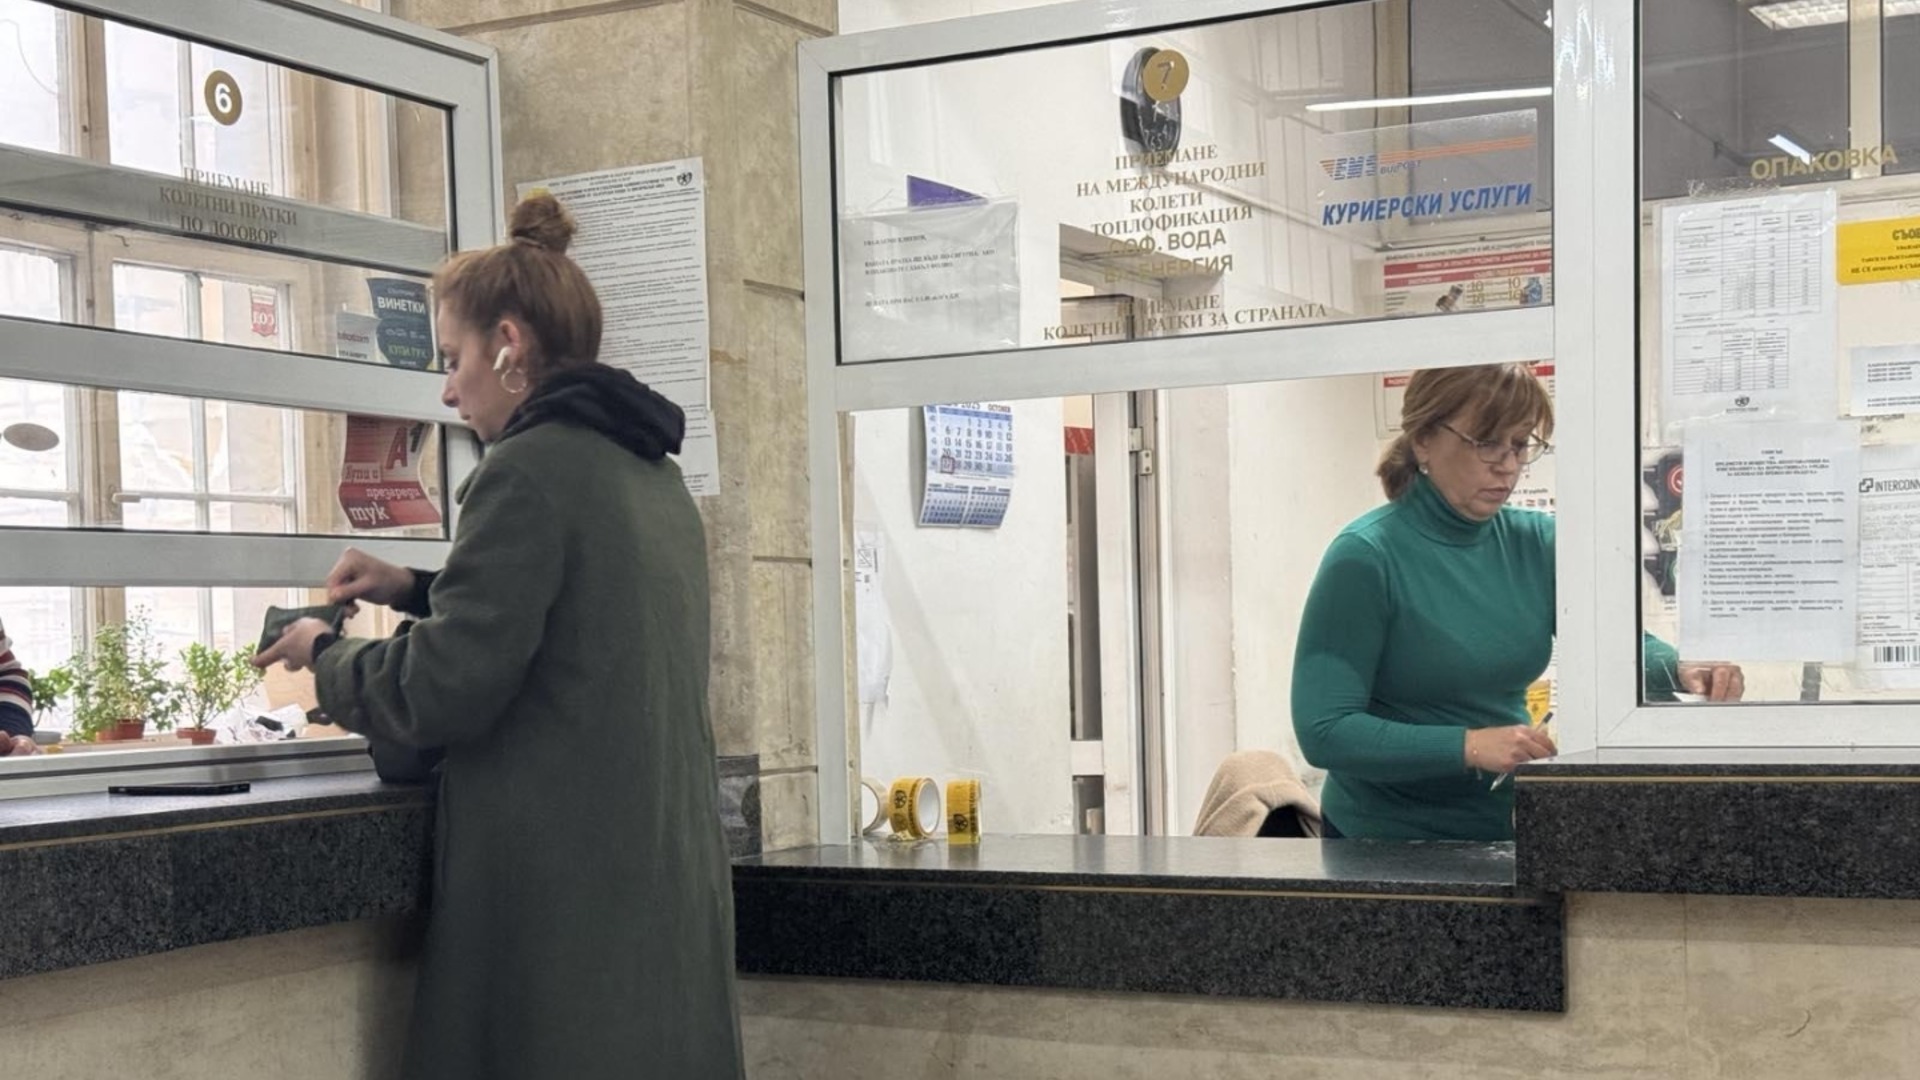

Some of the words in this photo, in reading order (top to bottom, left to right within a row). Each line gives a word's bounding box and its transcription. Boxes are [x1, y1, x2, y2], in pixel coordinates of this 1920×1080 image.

[214, 82, 232, 113] 6
[1115, 144, 1218, 171] ПРИЕМАНЕ
[1751, 144, 1899, 180] ОПАКОВКА
[183, 167, 270, 197] ПРИЕМАНЕ
[1076, 182, 1101, 197] НА
[1106, 161, 1266, 194] МЕЖДУНАРОДНИ
[160, 186, 235, 215] КОЛЕТНИ
[240, 202, 297, 225] ПРАТКИ
[1130, 192, 1203, 213] КОЛЕТИ
[1322, 193, 1443, 226] КУРИЕРСКИ
[1450, 183, 1532, 213] УСЛУГИ
[180, 215, 203, 232] ПО
[211, 219, 278, 244] ДОГОВОР
[1091, 205, 1253, 238] ТОПЛОФИКАЦИЯ
[1168, 228, 1226, 251] ВОДА
[1138, 254, 1233, 280] ЕНЕРГИЯ
[377, 296, 426, 315] ВИНЕТКИ
[1209, 312, 1229, 328] ЗА
[1234, 303, 1327, 324] СТРАНАТА
[365, 487, 421, 501] презареди
[349, 501, 390, 525] тук
